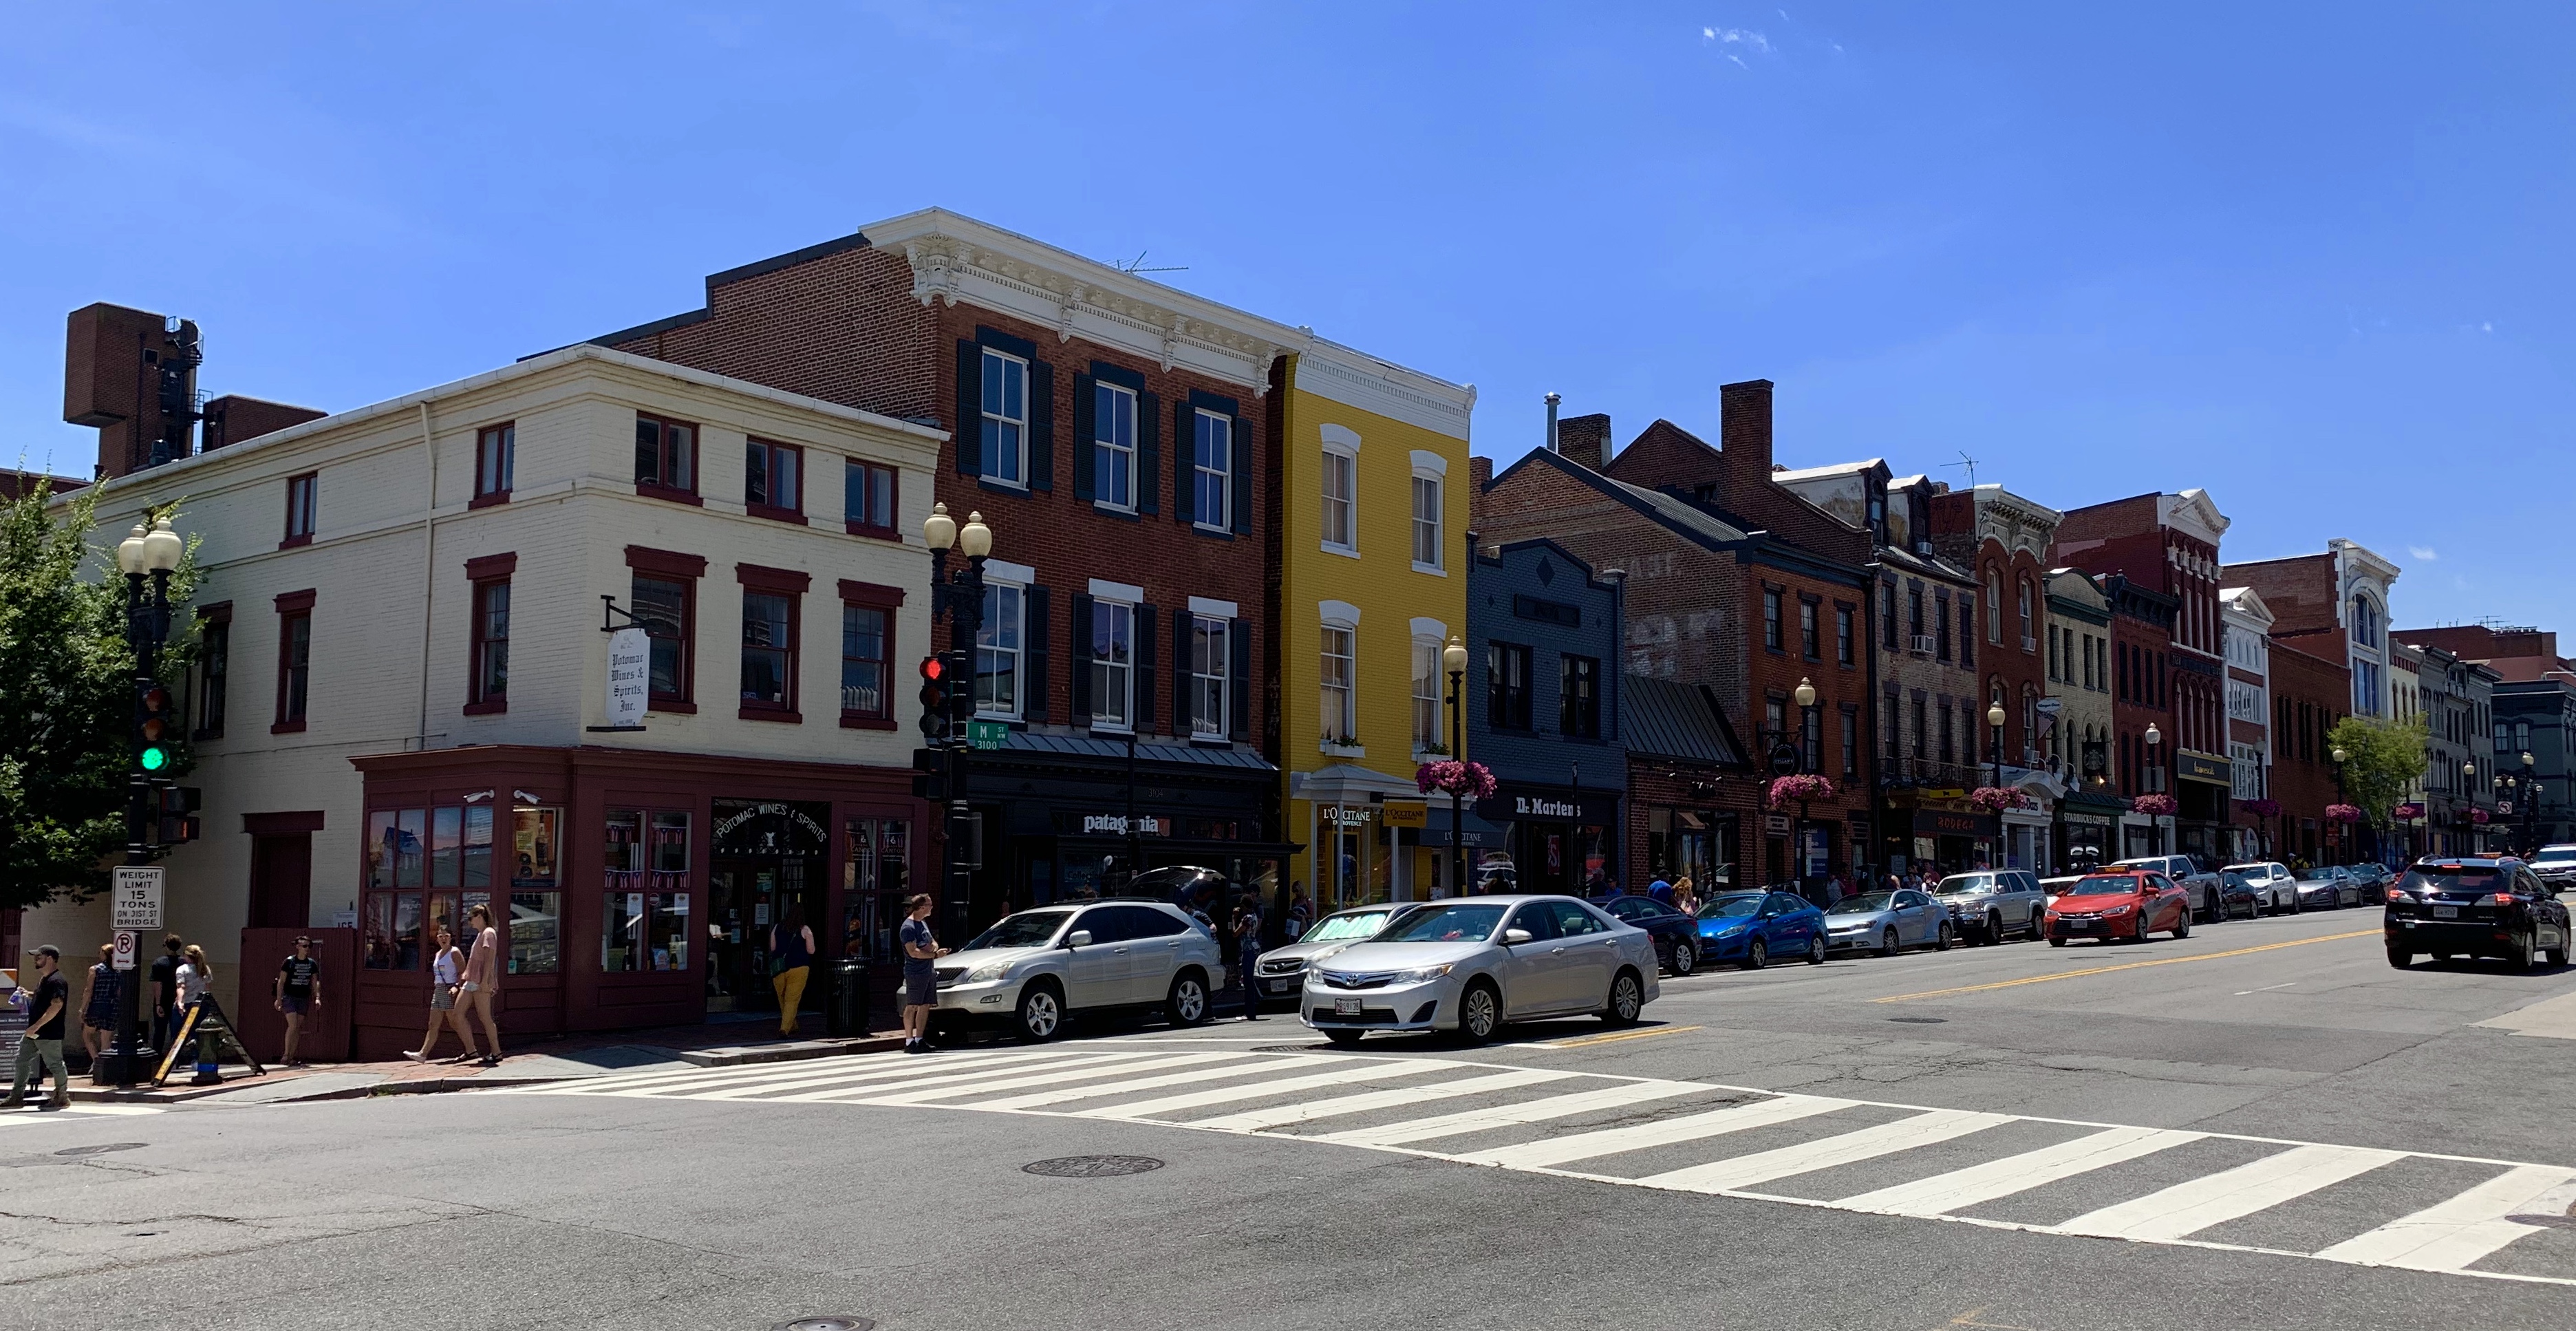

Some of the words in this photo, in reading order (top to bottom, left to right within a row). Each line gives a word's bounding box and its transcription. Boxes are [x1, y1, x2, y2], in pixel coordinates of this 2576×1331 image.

[612, 654, 643, 668] Potomac
[611, 670, 634, 681] Wines
[637, 667, 643, 679] &
[620, 700, 636, 712] Inc.
[980, 725, 987, 738] M
[977, 741, 997, 750] 3100
[1386, 809, 1424, 818] L'OCCITANE
[1516, 797, 1530, 814] Dr.
[1532, 798, 1581, 817] Martens
[1323, 807, 1371, 822] L'OCITANE
[2063, 812, 2092, 824] STARBUCKS
[2092, 814, 2110, 826] COFFEE
[716, 807, 755, 838] POTOMAC
[758, 803, 788, 816] WINES
[796, 813, 827, 842] SPIRITS
[1083, 813, 1159, 835] patagnia
[1937, 815, 1975, 831] BODEGA
[131, 891, 145, 899] 15
